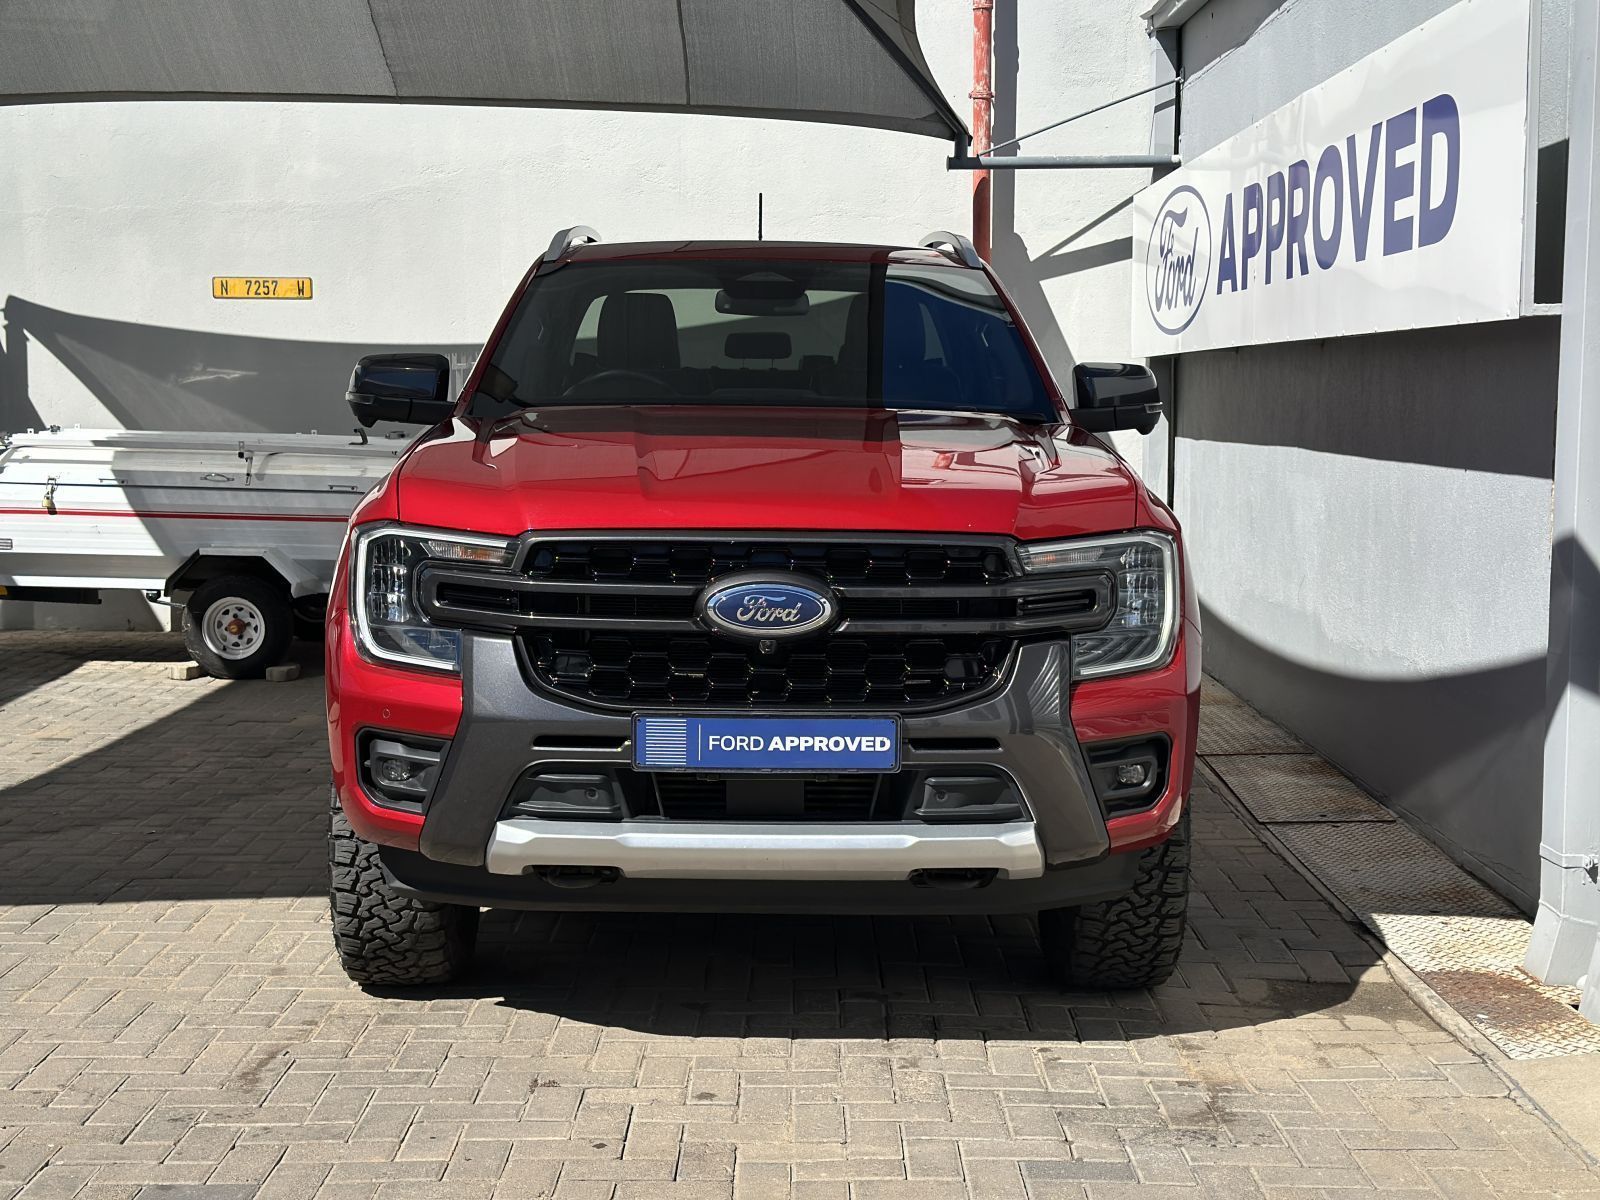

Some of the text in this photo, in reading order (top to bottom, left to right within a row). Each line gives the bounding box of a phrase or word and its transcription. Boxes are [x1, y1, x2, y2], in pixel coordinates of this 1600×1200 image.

[1154, 93, 1460, 312] Ford APPROVED
[220, 279, 229, 296] N
[245, 279, 279, 296] 7257
[736, 594, 802, 623] Ford
[708, 734, 891, 753] FORD APPROVED
